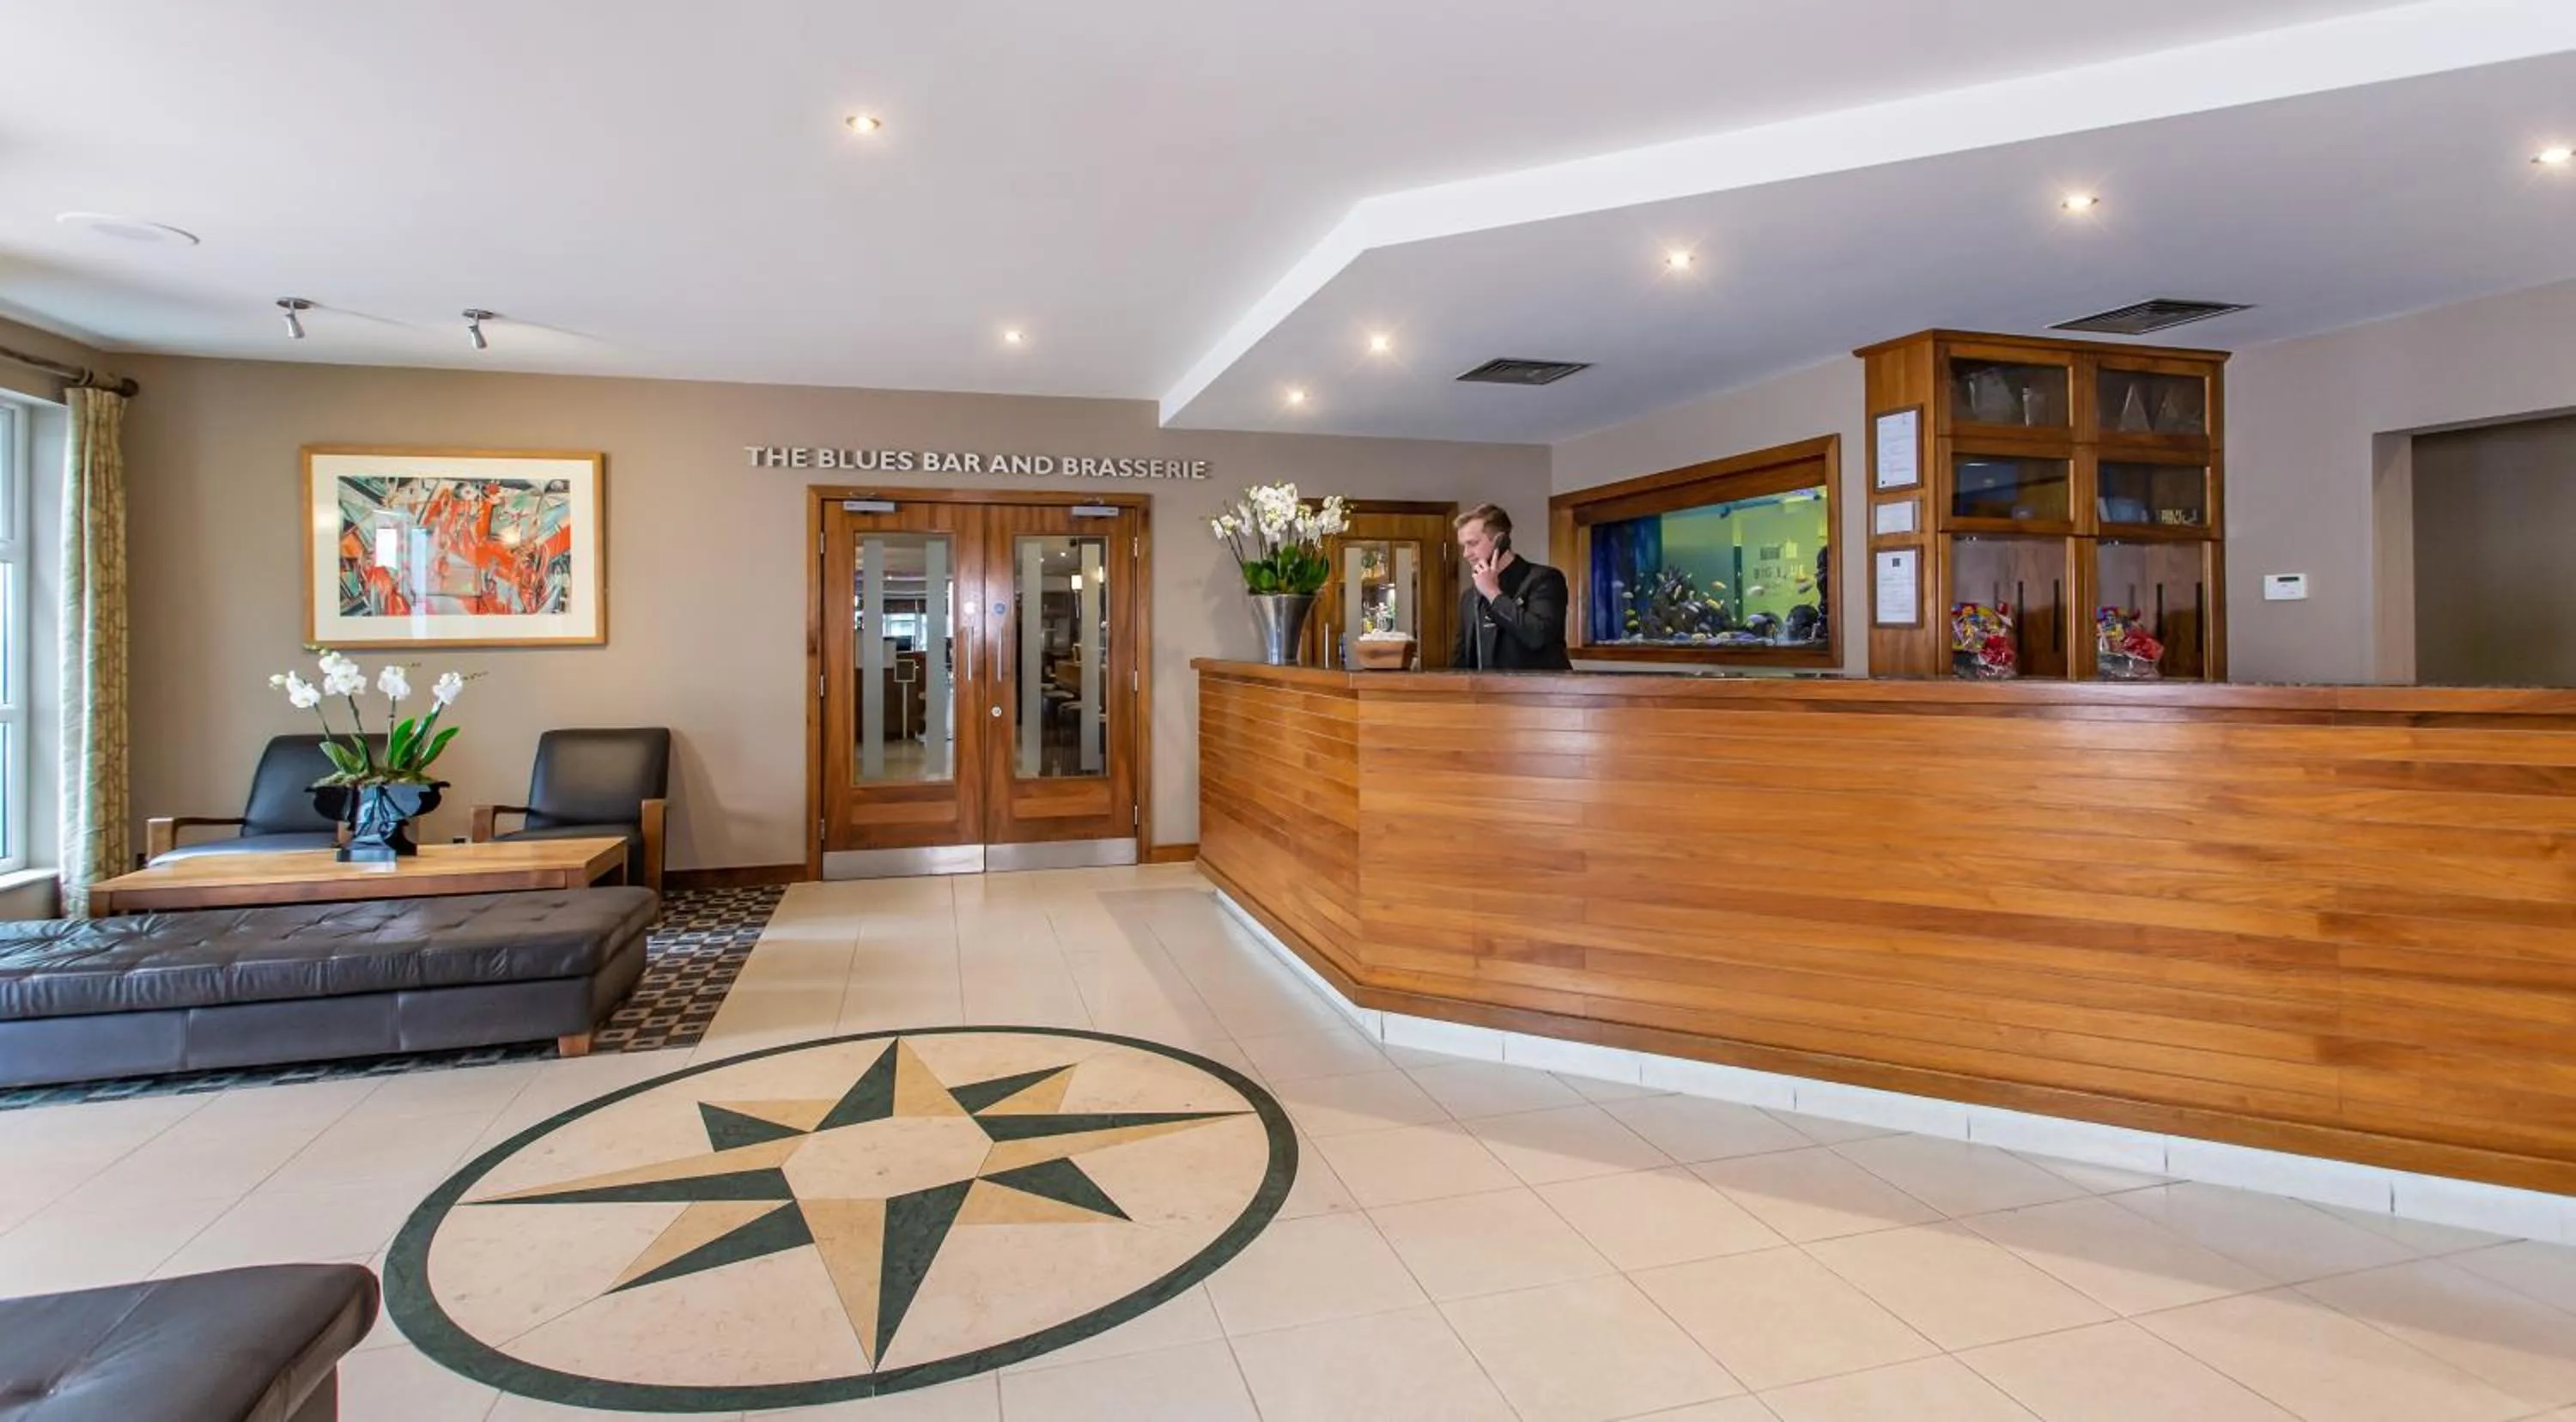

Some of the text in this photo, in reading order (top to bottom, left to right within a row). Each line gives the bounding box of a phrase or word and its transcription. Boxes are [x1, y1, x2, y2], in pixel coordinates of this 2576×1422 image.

[744, 446, 1206, 480] THE BLUES BAR AND BRASSERIE
